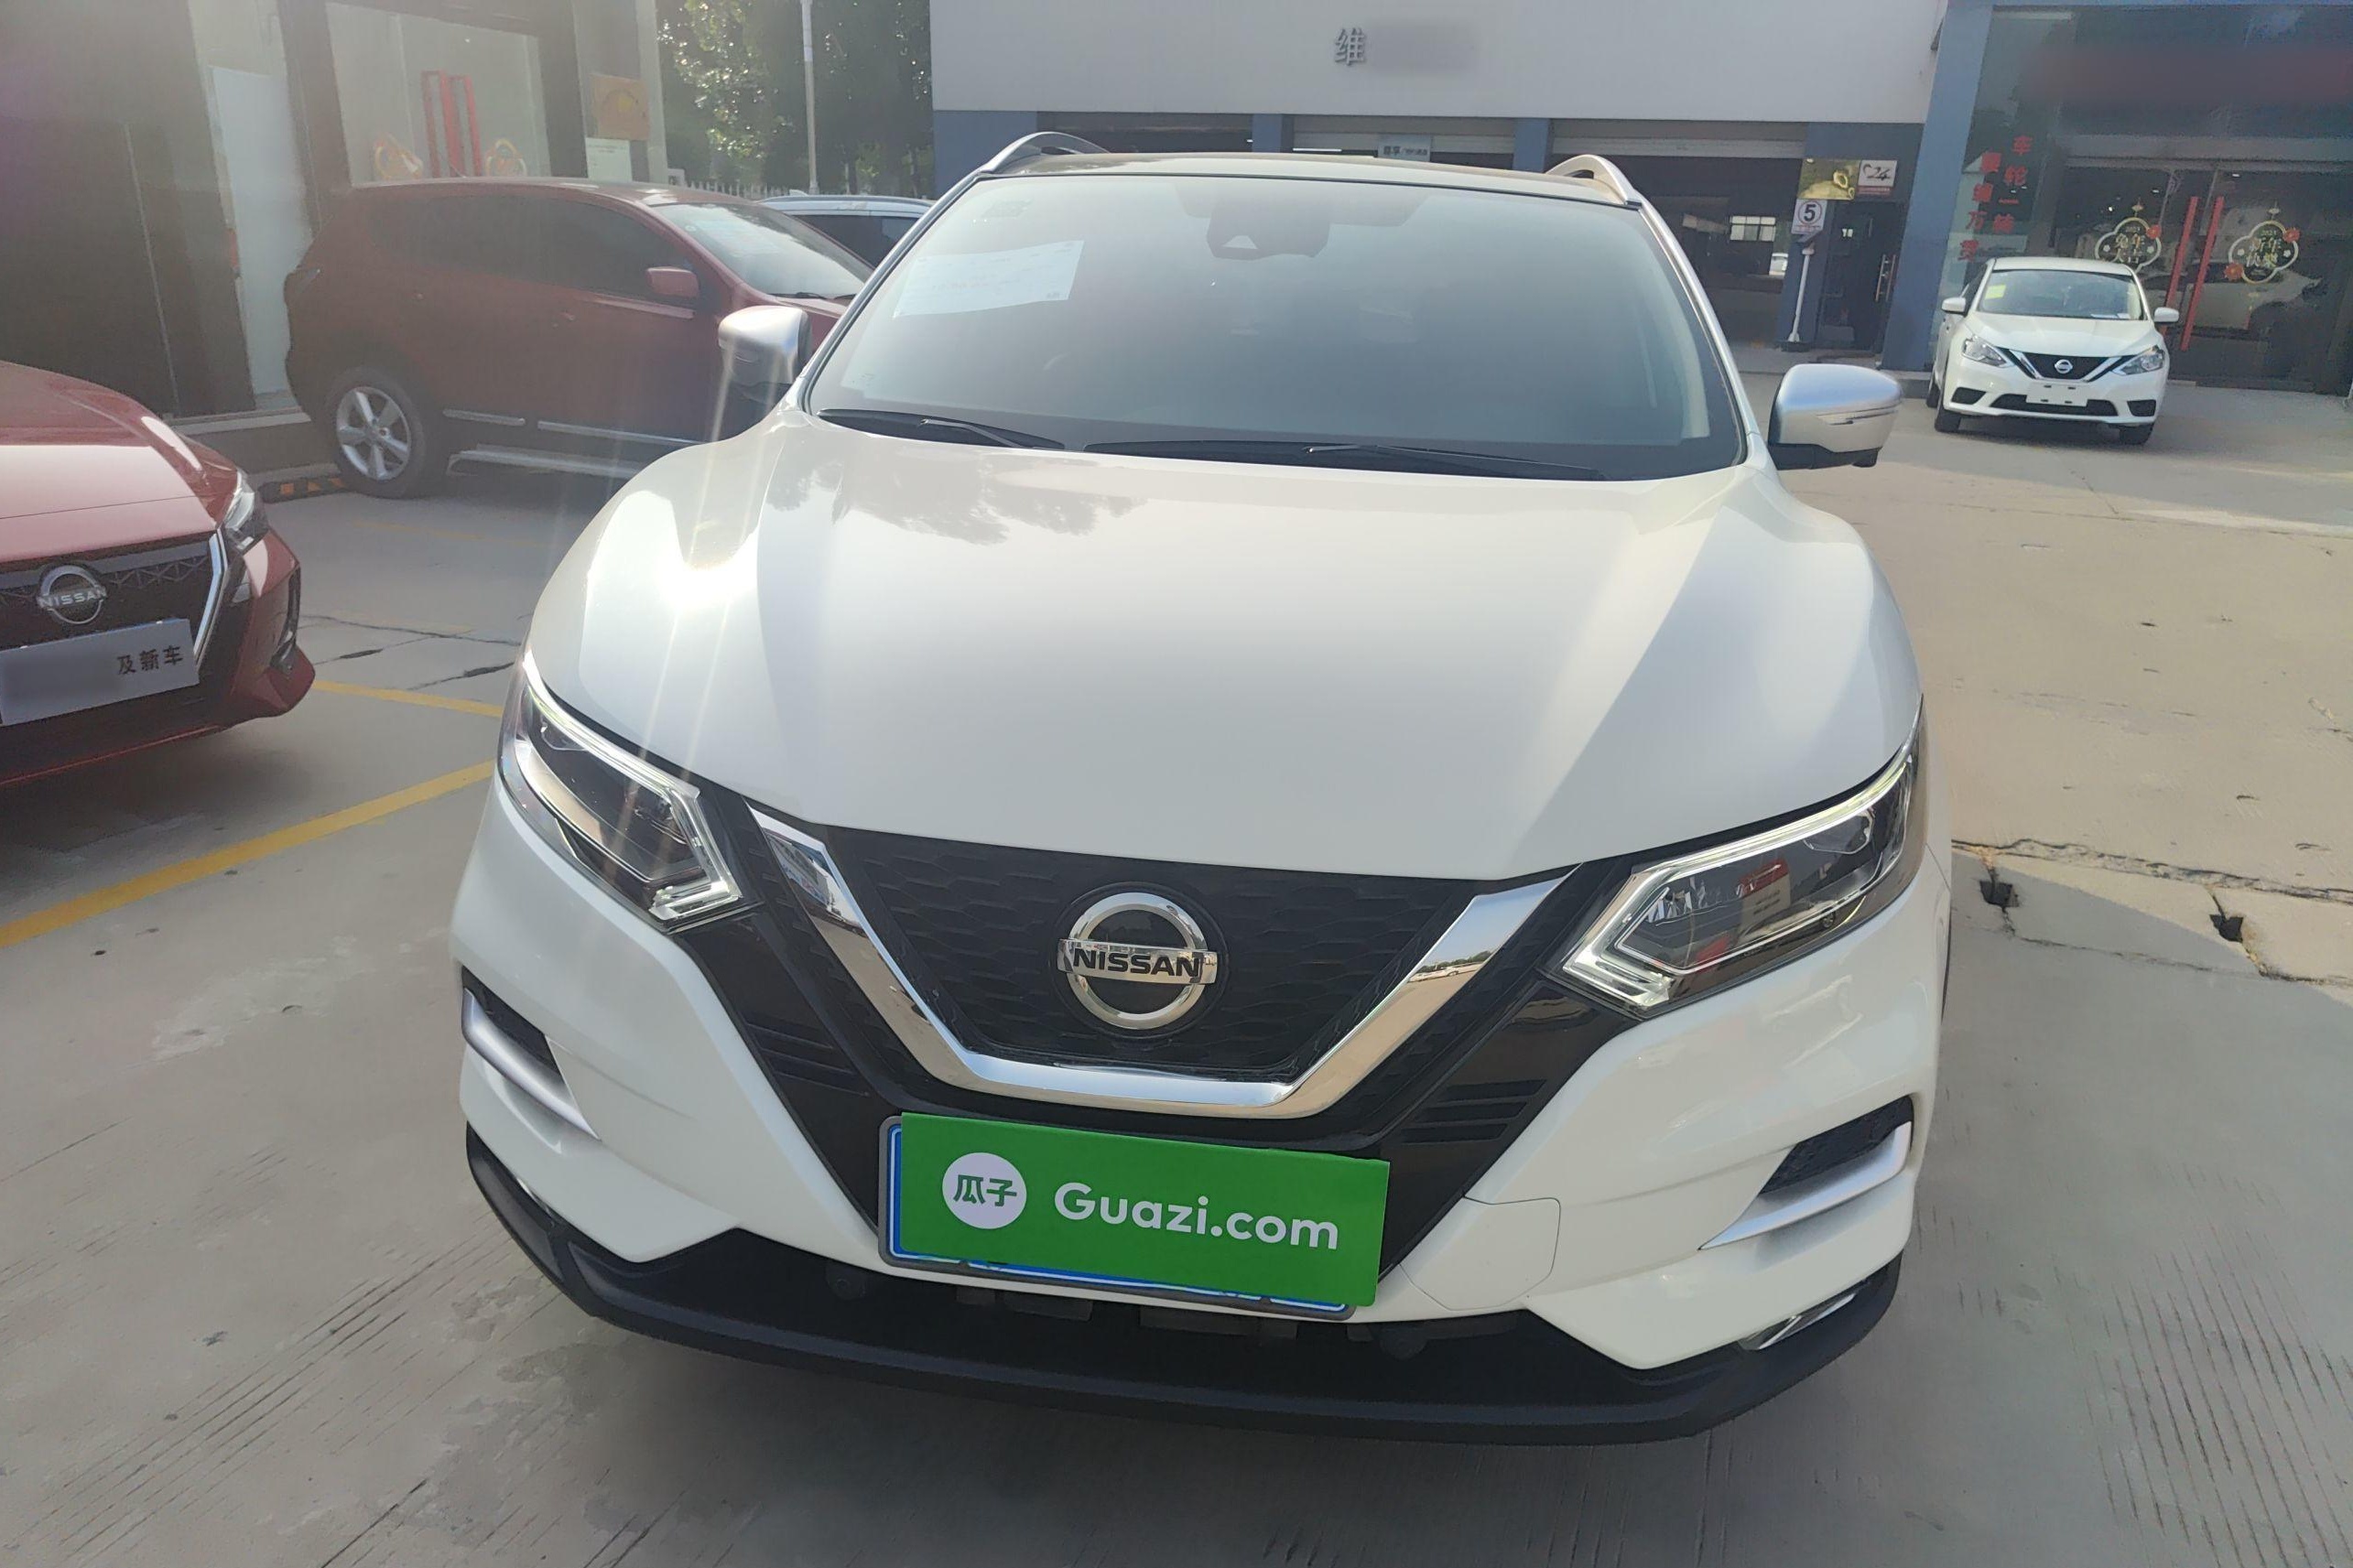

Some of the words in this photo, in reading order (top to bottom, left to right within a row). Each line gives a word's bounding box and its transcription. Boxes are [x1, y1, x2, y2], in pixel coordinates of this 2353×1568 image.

[1334, 27, 1366, 67] 维
[1803, 203, 1816, 222] 5
[38, 586, 107, 608] NISSAN
[117, 644, 183, 675] 及新车
[1073, 947, 1199, 978] NISSAN
